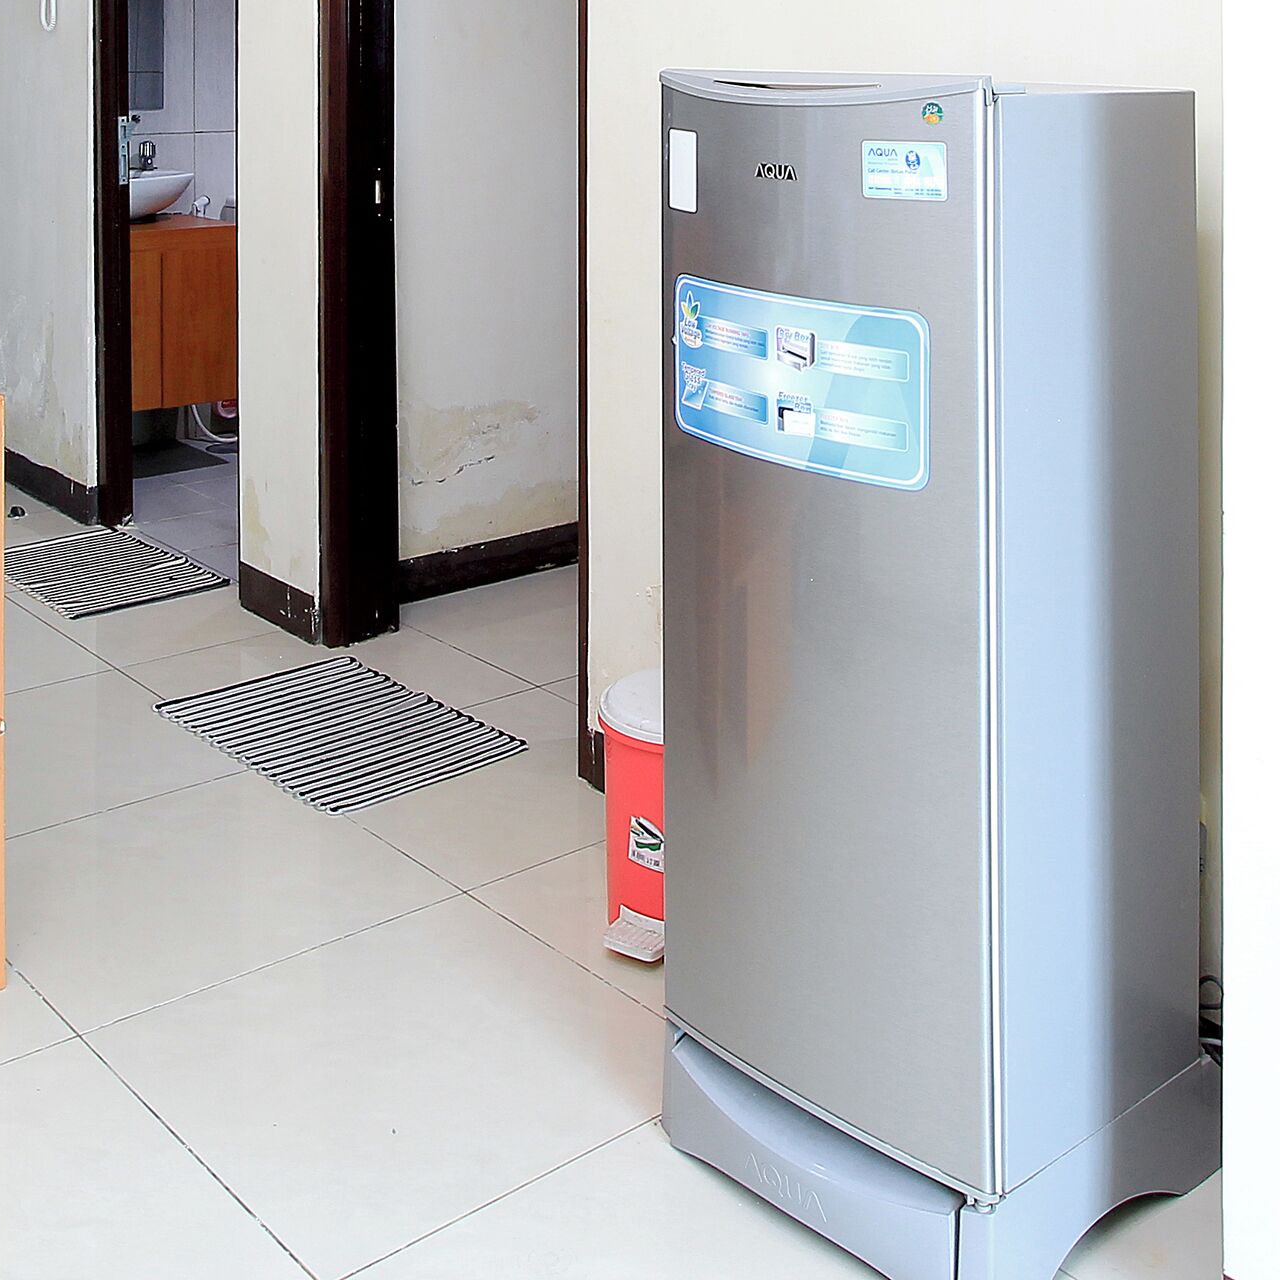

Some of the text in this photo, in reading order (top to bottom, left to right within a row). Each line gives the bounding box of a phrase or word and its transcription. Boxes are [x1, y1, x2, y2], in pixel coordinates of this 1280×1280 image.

[867, 147, 898, 157] AQUA
[754, 162, 798, 180] AQUA
[745, 1152, 827, 1222] AQUA
